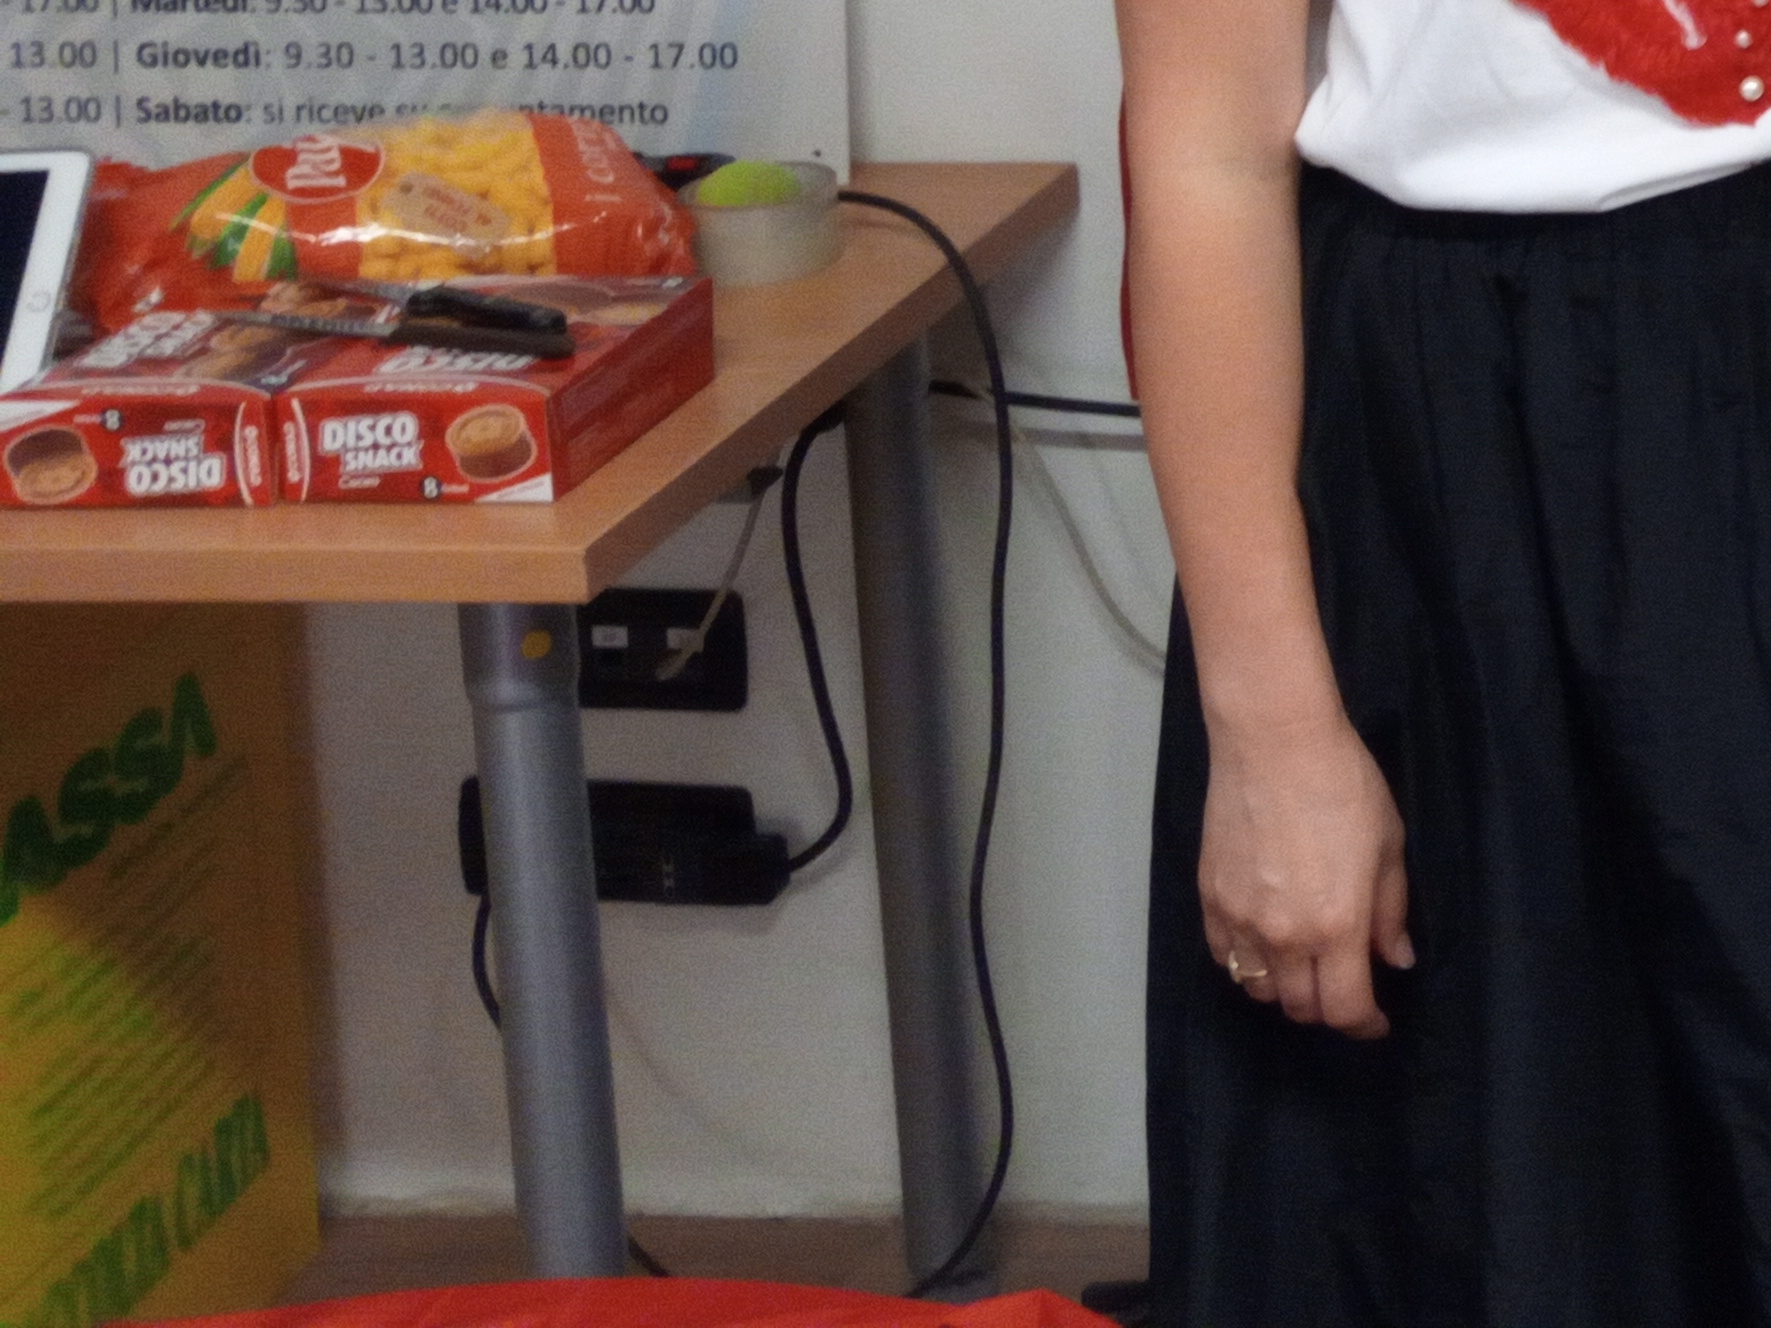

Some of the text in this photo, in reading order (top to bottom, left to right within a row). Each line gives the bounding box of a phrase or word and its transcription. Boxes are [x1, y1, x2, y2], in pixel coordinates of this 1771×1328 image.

[11, 41, 97, 69] 13.00
[136, 41, 272, 70] Giovedì:
[284, 42, 355, 70] 9.30
[391, 42, 479, 70] 13.00
[491, 50, 508, 70] e
[522, 42, 612, 70] 14.00
[649, 42, 739, 70] 17.00
[20, 96, 102, 124] 13.00
[136, 96, 254, 124] Sabato:
[263, 98, 284, 124] si
[294, 98, 386, 124] riceve
[322, 414, 418, 452] DISCO
[125, 436, 200, 462] SNACK
[344, 446, 421, 471] SNACK
[127, 456, 223, 495] DISCO
